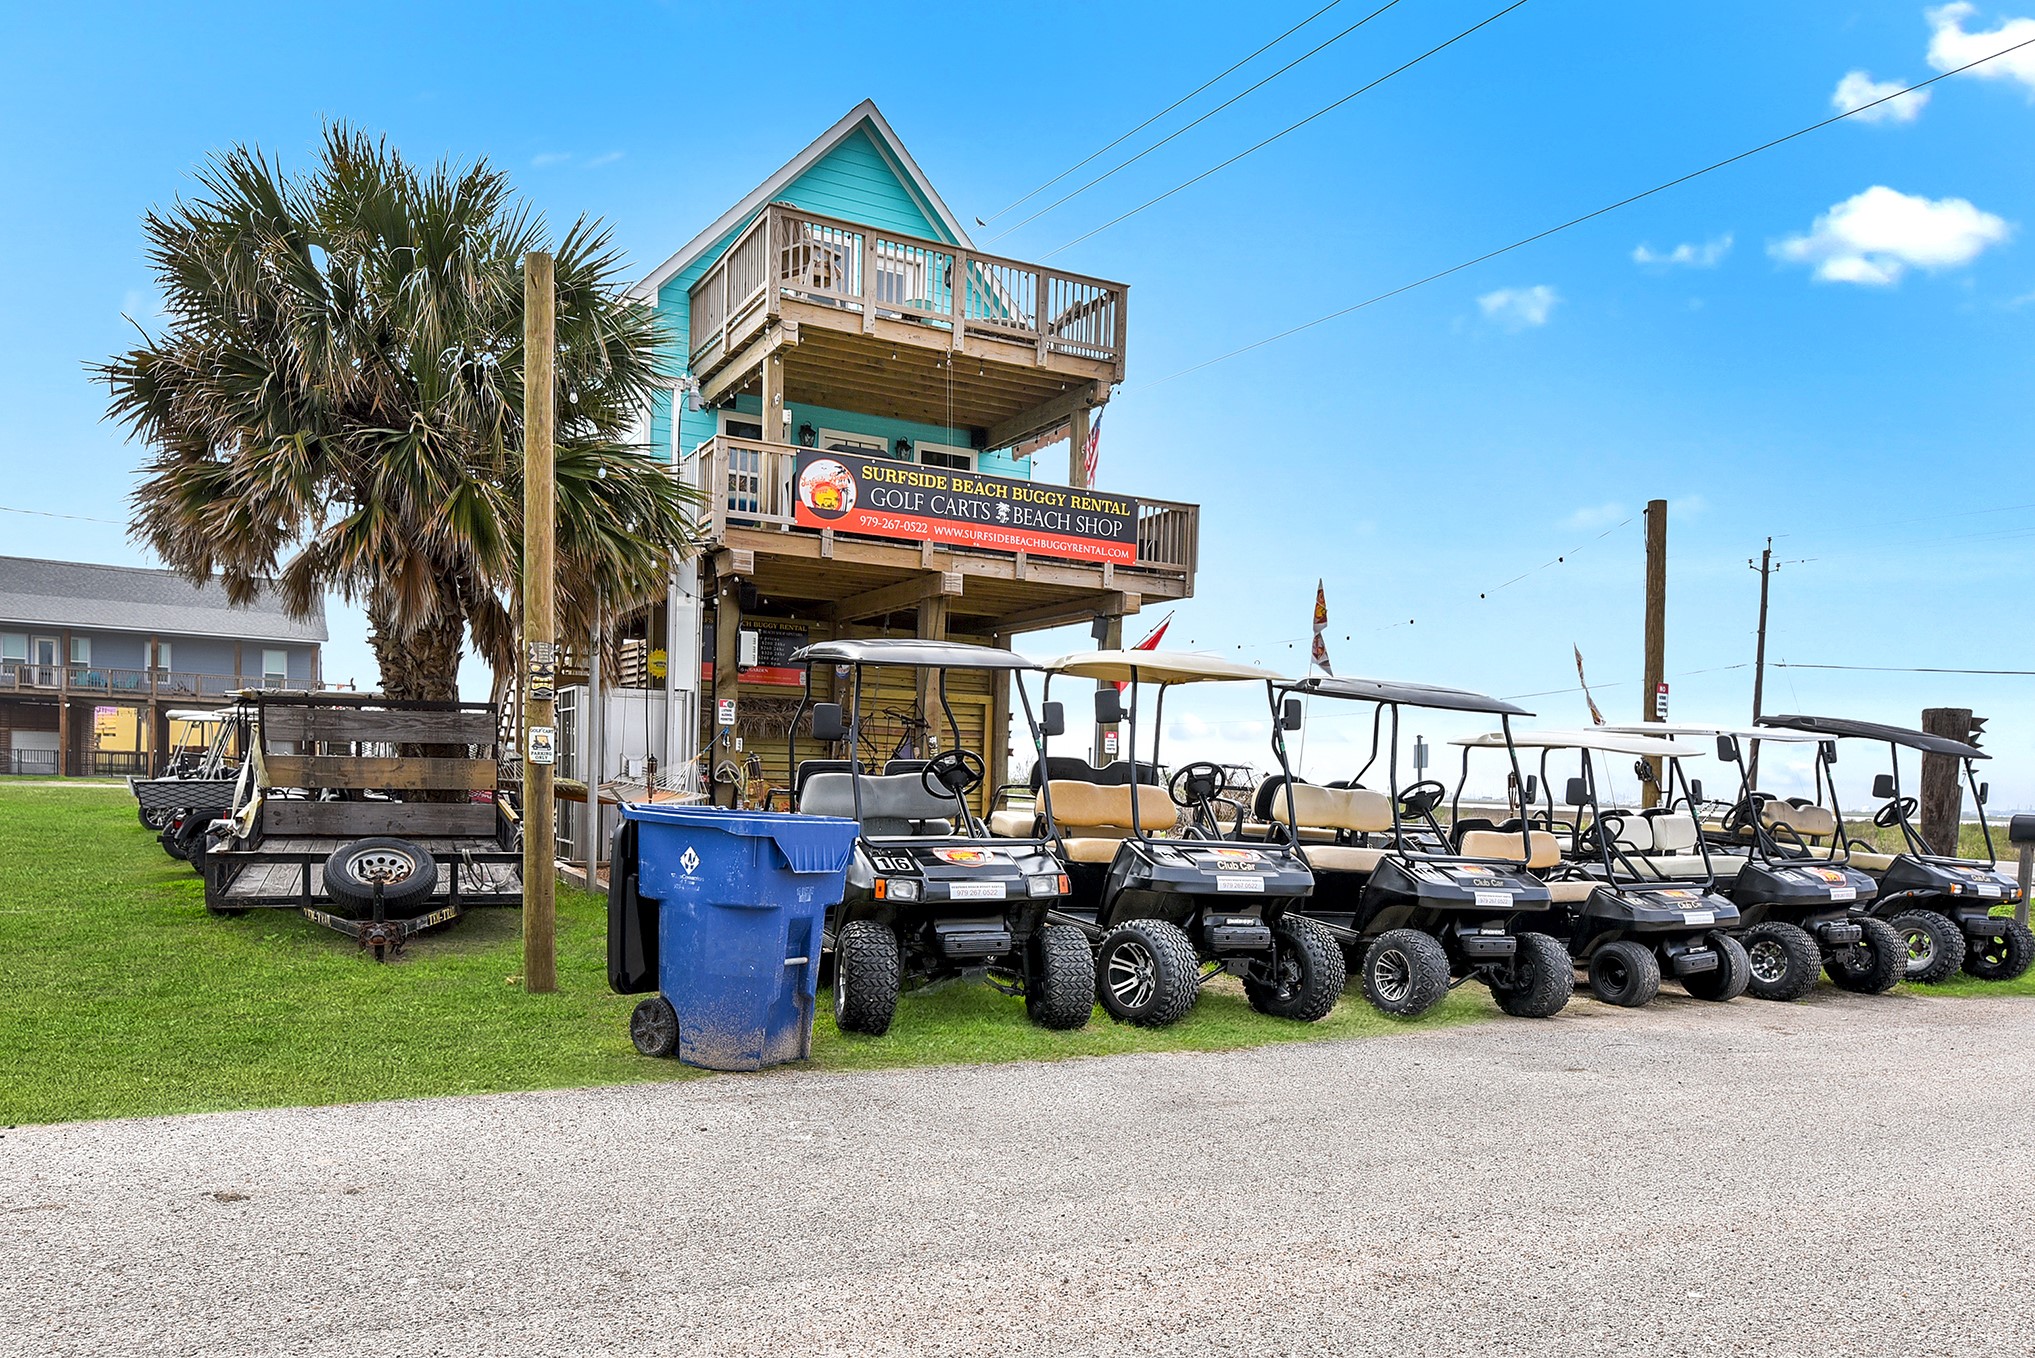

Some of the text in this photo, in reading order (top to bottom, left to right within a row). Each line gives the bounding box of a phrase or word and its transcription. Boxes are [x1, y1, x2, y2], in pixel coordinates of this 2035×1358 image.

[861, 465, 1131, 517] SURFSIDE BEACH BUGGY RENTAL
[870, 487, 1123, 537] GOLF CARTS BEACH SHOP
[859, 515, 1129, 559] 979-267-0522 WWW.SURFSIDEBEACHBUGGYRENTAL.COM
[753, 621, 778, 629] BUGGY
[780, 623, 808, 632] RENTAL
[876, 857, 911, 870] 16
[1216, 860, 1256, 871] Club Car
[1472, 878, 1504, 887] Club Car
[957, 889, 969, 897] 979
[970, 889, 981, 897] 267
